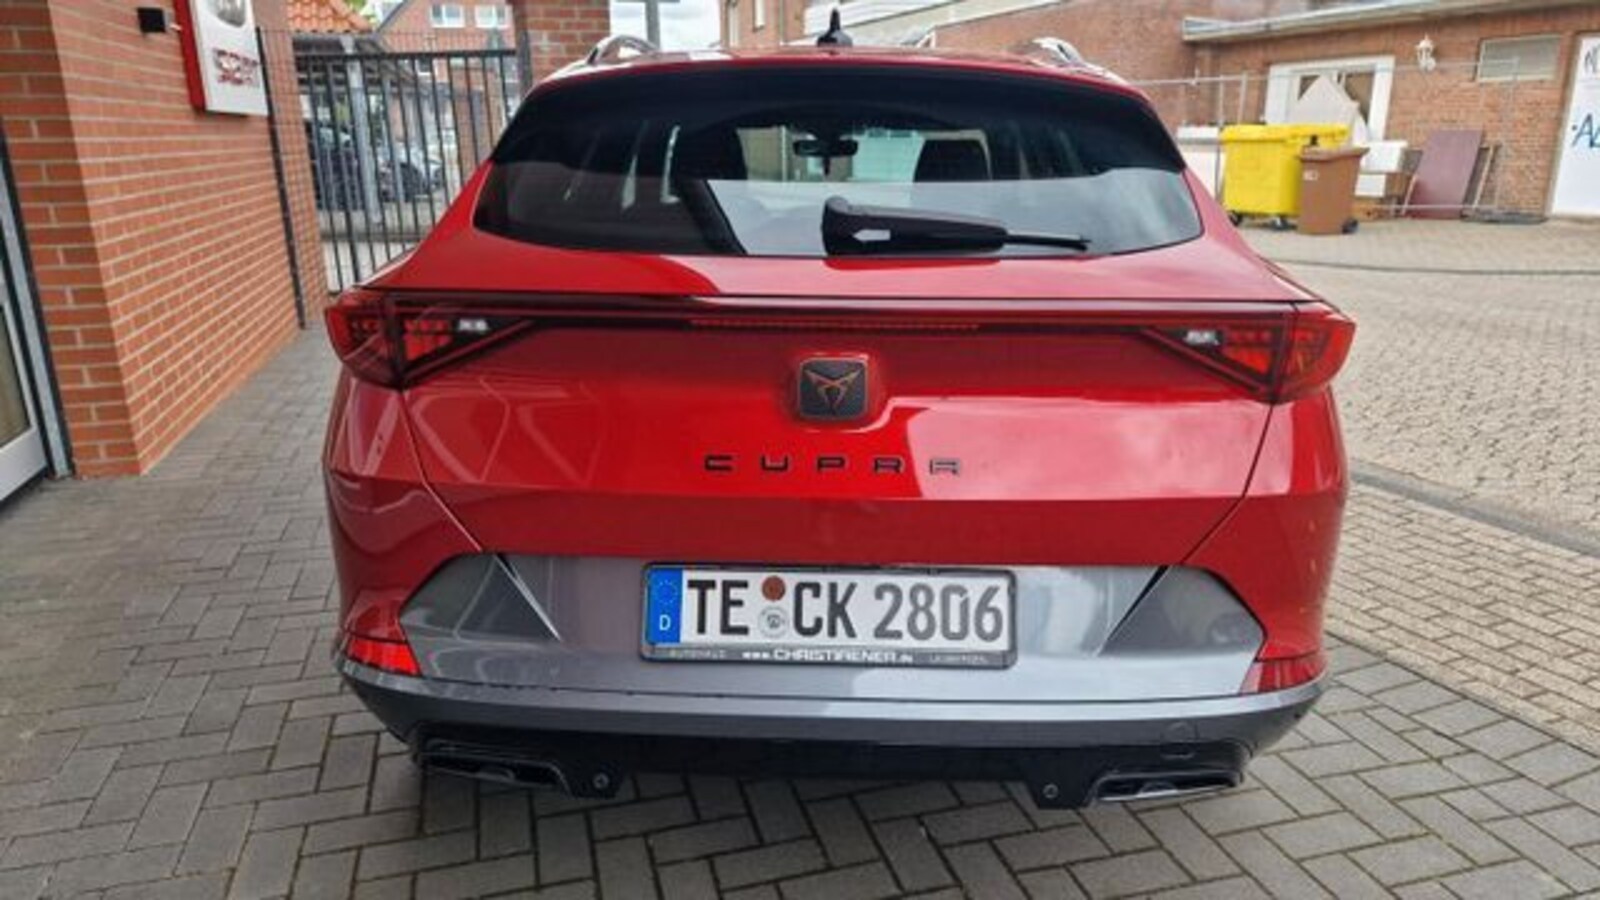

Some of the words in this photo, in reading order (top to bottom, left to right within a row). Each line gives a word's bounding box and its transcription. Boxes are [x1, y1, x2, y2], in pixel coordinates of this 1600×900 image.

[704, 454, 962, 475] CUPRA
[687, 579, 749, 635] TE
[794, 581, 858, 638] CK
[873, 582, 1003, 642] 2806
[659, 613, 671, 631] D
